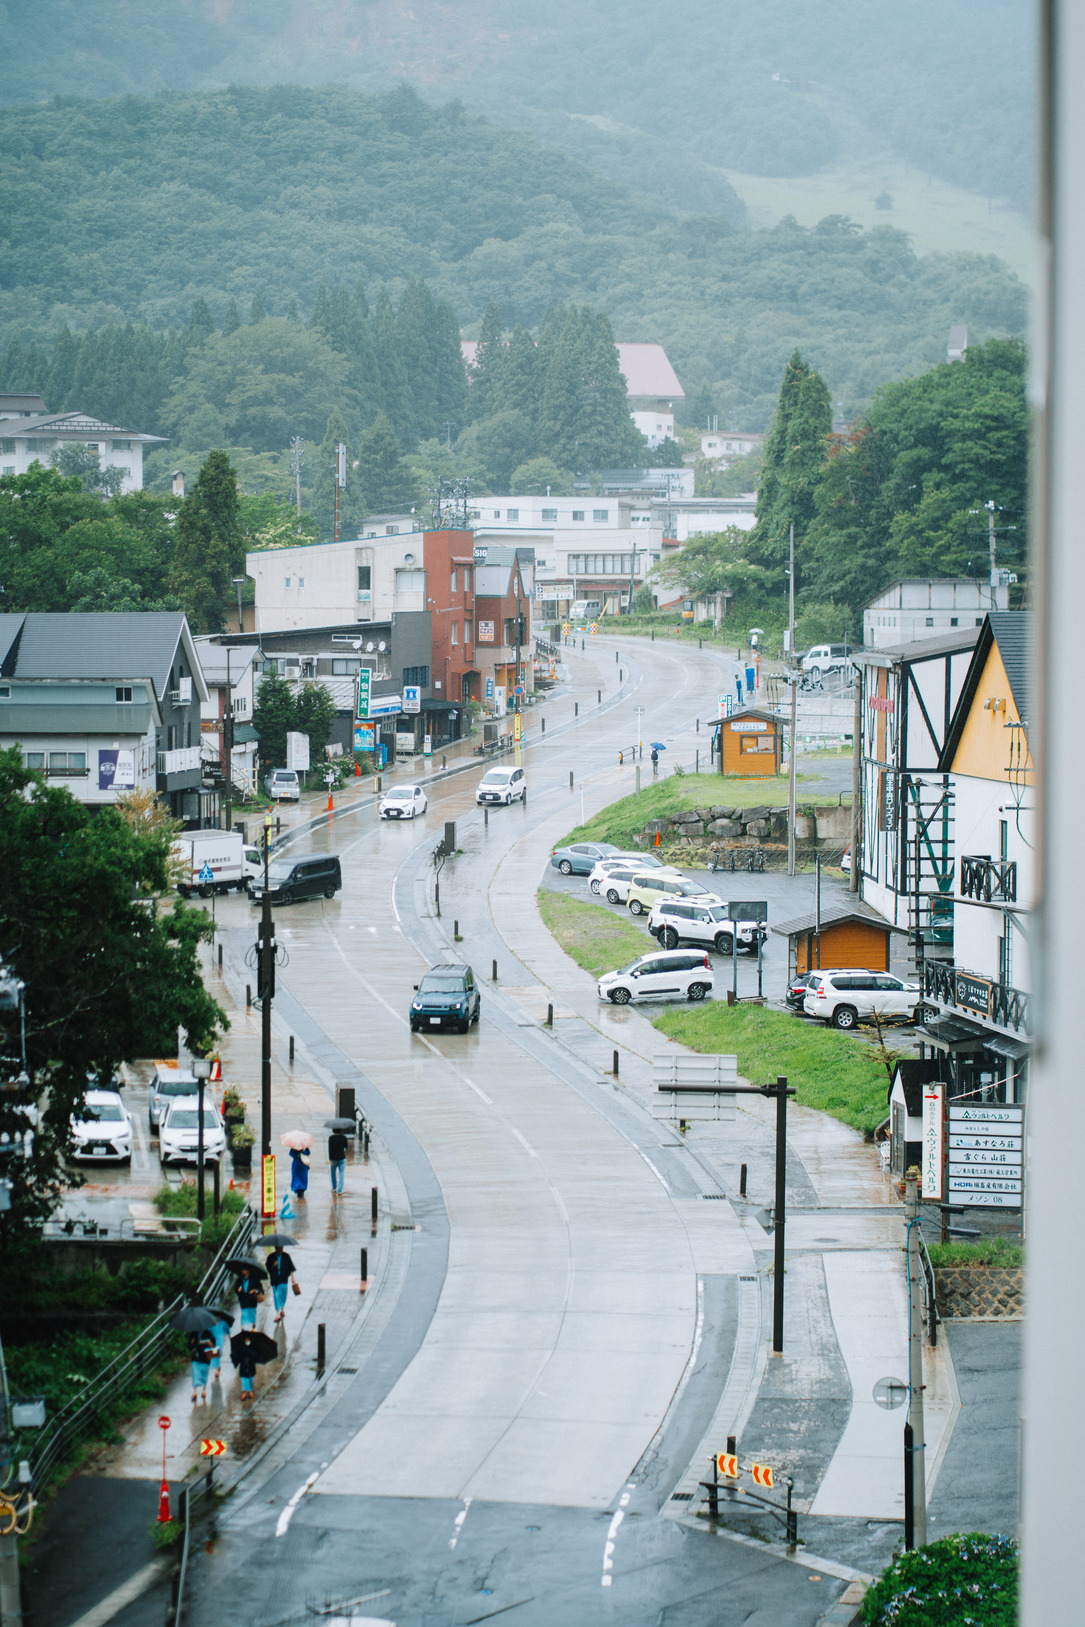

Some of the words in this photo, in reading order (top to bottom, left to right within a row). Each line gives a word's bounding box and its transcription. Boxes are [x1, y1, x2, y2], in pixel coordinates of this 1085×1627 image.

[974, 1139, 1014, 1148] あすなろ荘
